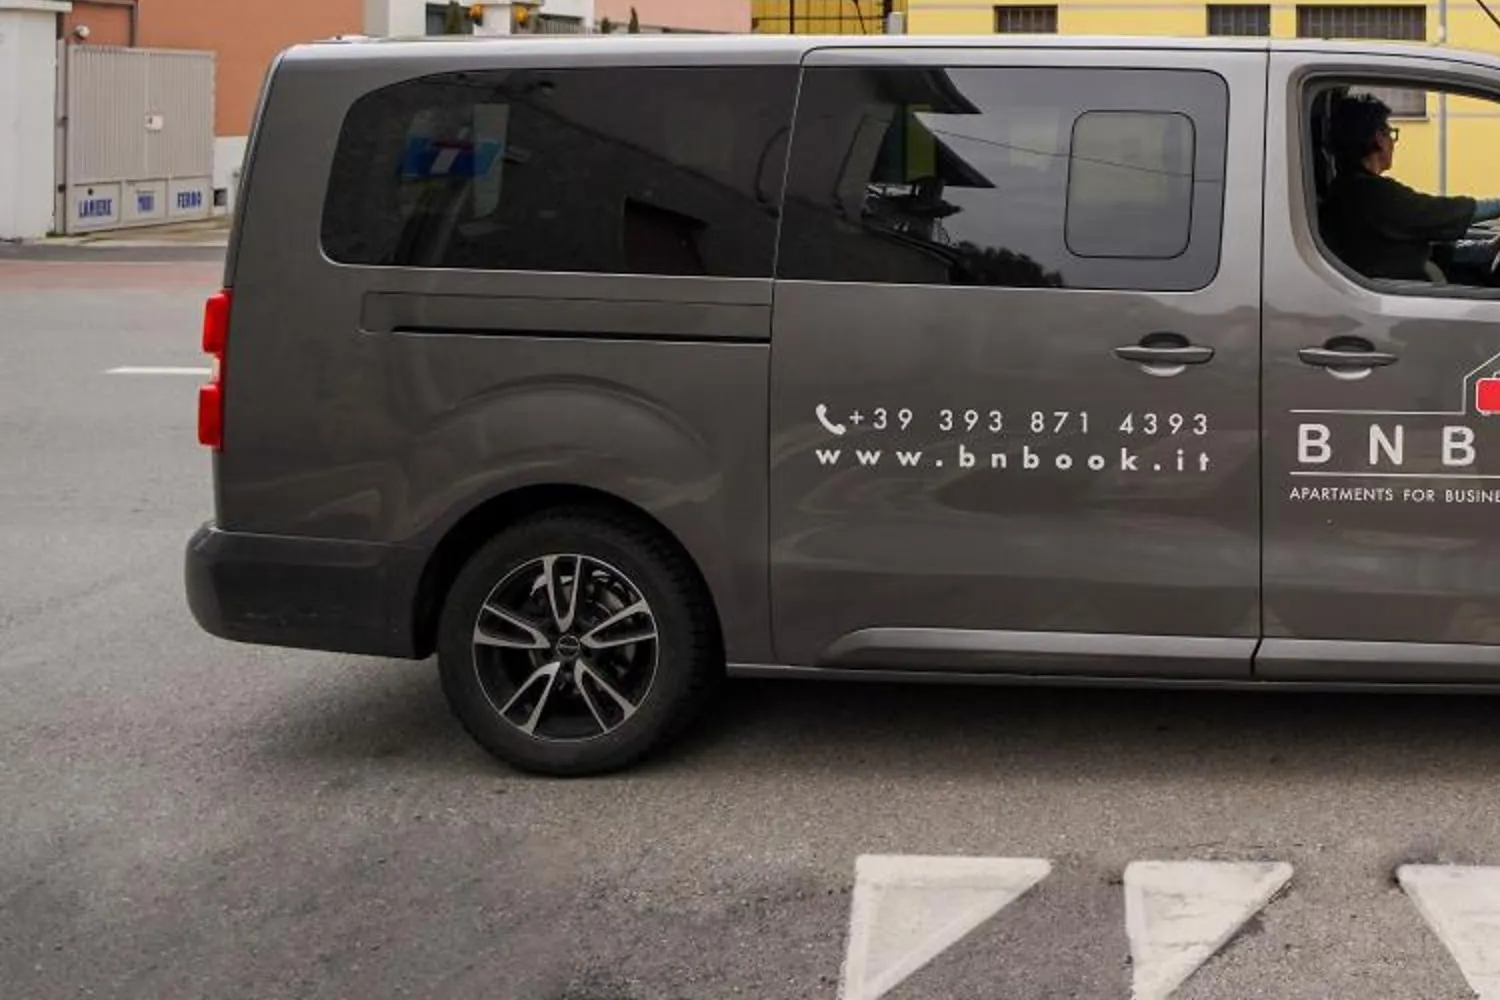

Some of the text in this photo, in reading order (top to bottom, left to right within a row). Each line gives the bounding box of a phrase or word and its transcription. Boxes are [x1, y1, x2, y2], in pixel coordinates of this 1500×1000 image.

[849, 408, 1207, 435] +39 393 871 4393
[815, 444, 1210, 471] www.bnbook.it
[1289, 486, 1394, 502] APARTMENTS
[1403, 488, 1435, 502] FOR
